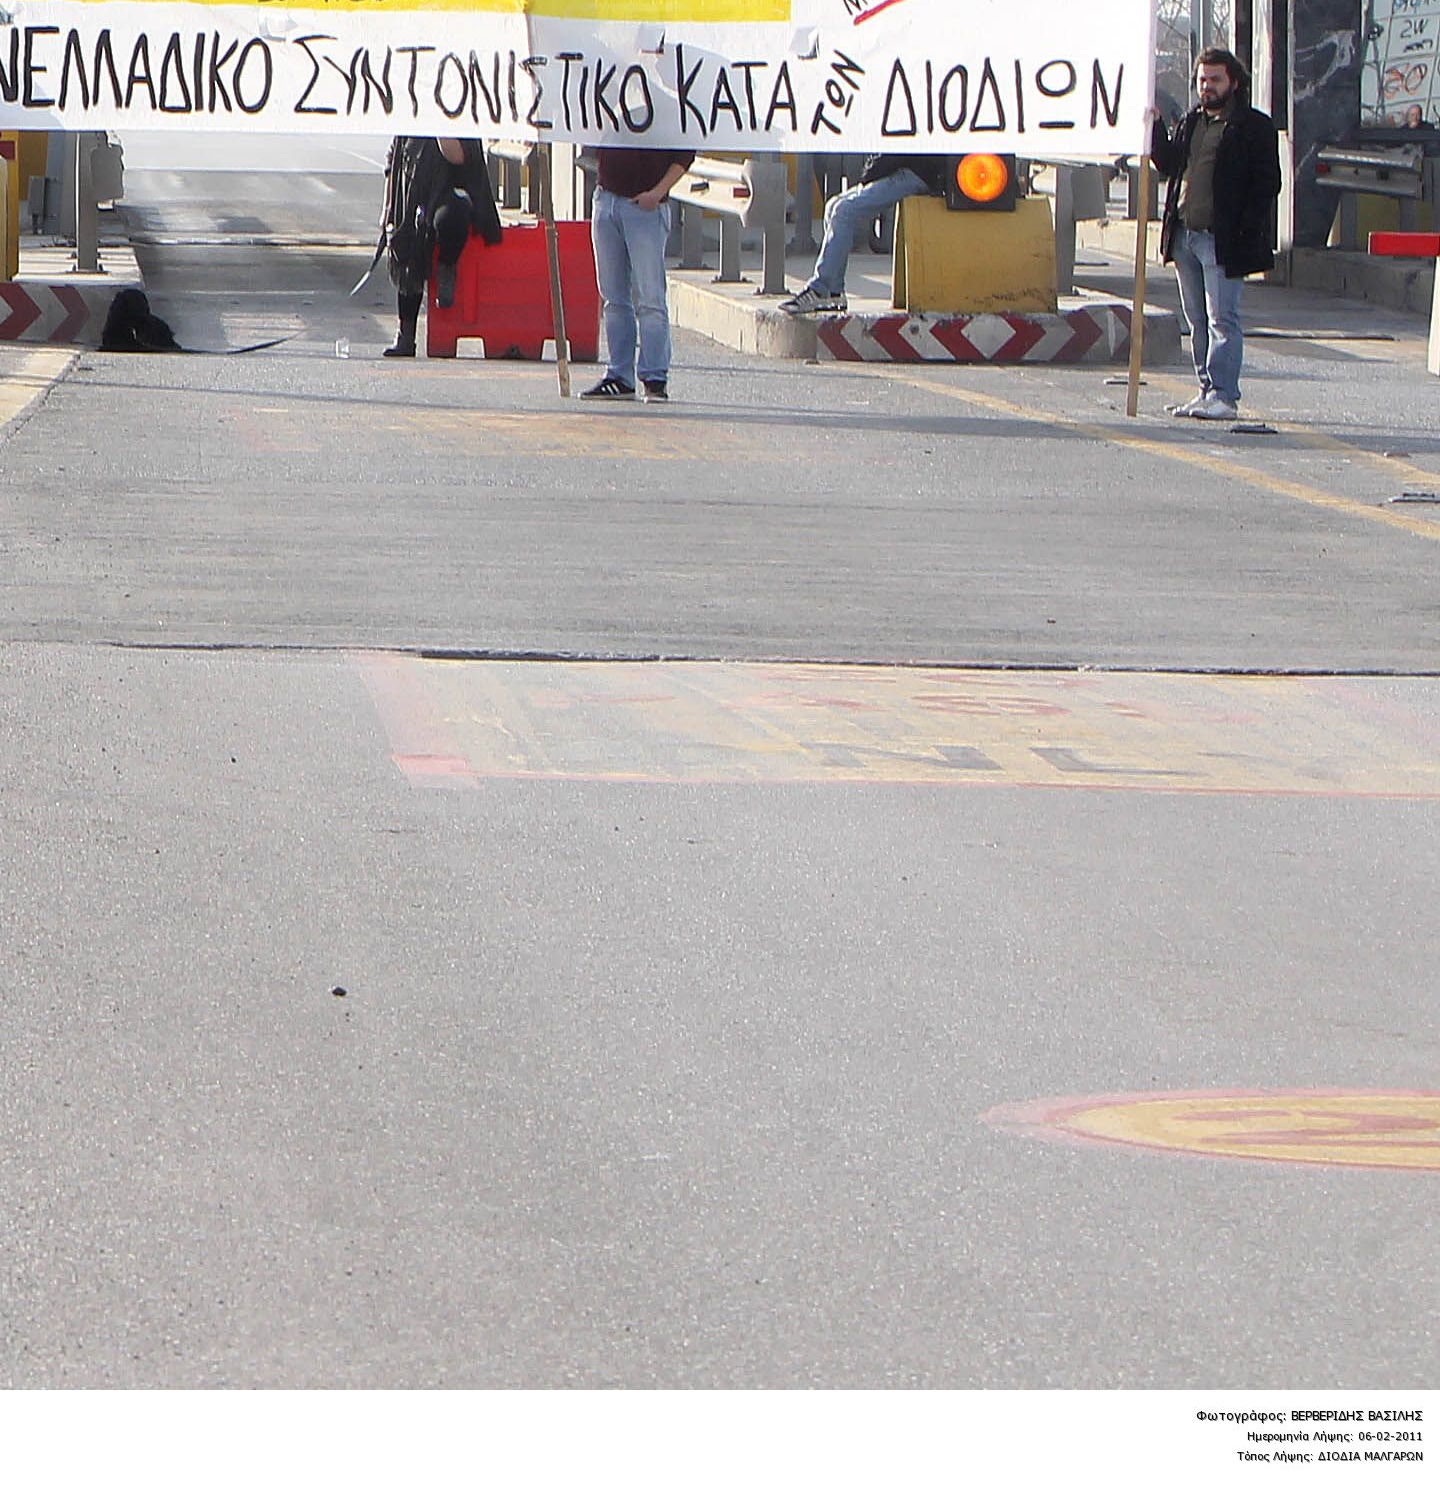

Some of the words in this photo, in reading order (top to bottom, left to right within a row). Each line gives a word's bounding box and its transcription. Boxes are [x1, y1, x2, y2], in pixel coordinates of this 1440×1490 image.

[293, 35, 650, 134] ΣΥΝΤΟΝΙΣΤΙΚΟ
[675, 43, 799, 139] ΚΑΤΑ
[880, 57, 1124, 136] ΔΙΟΔΙΩΝ
